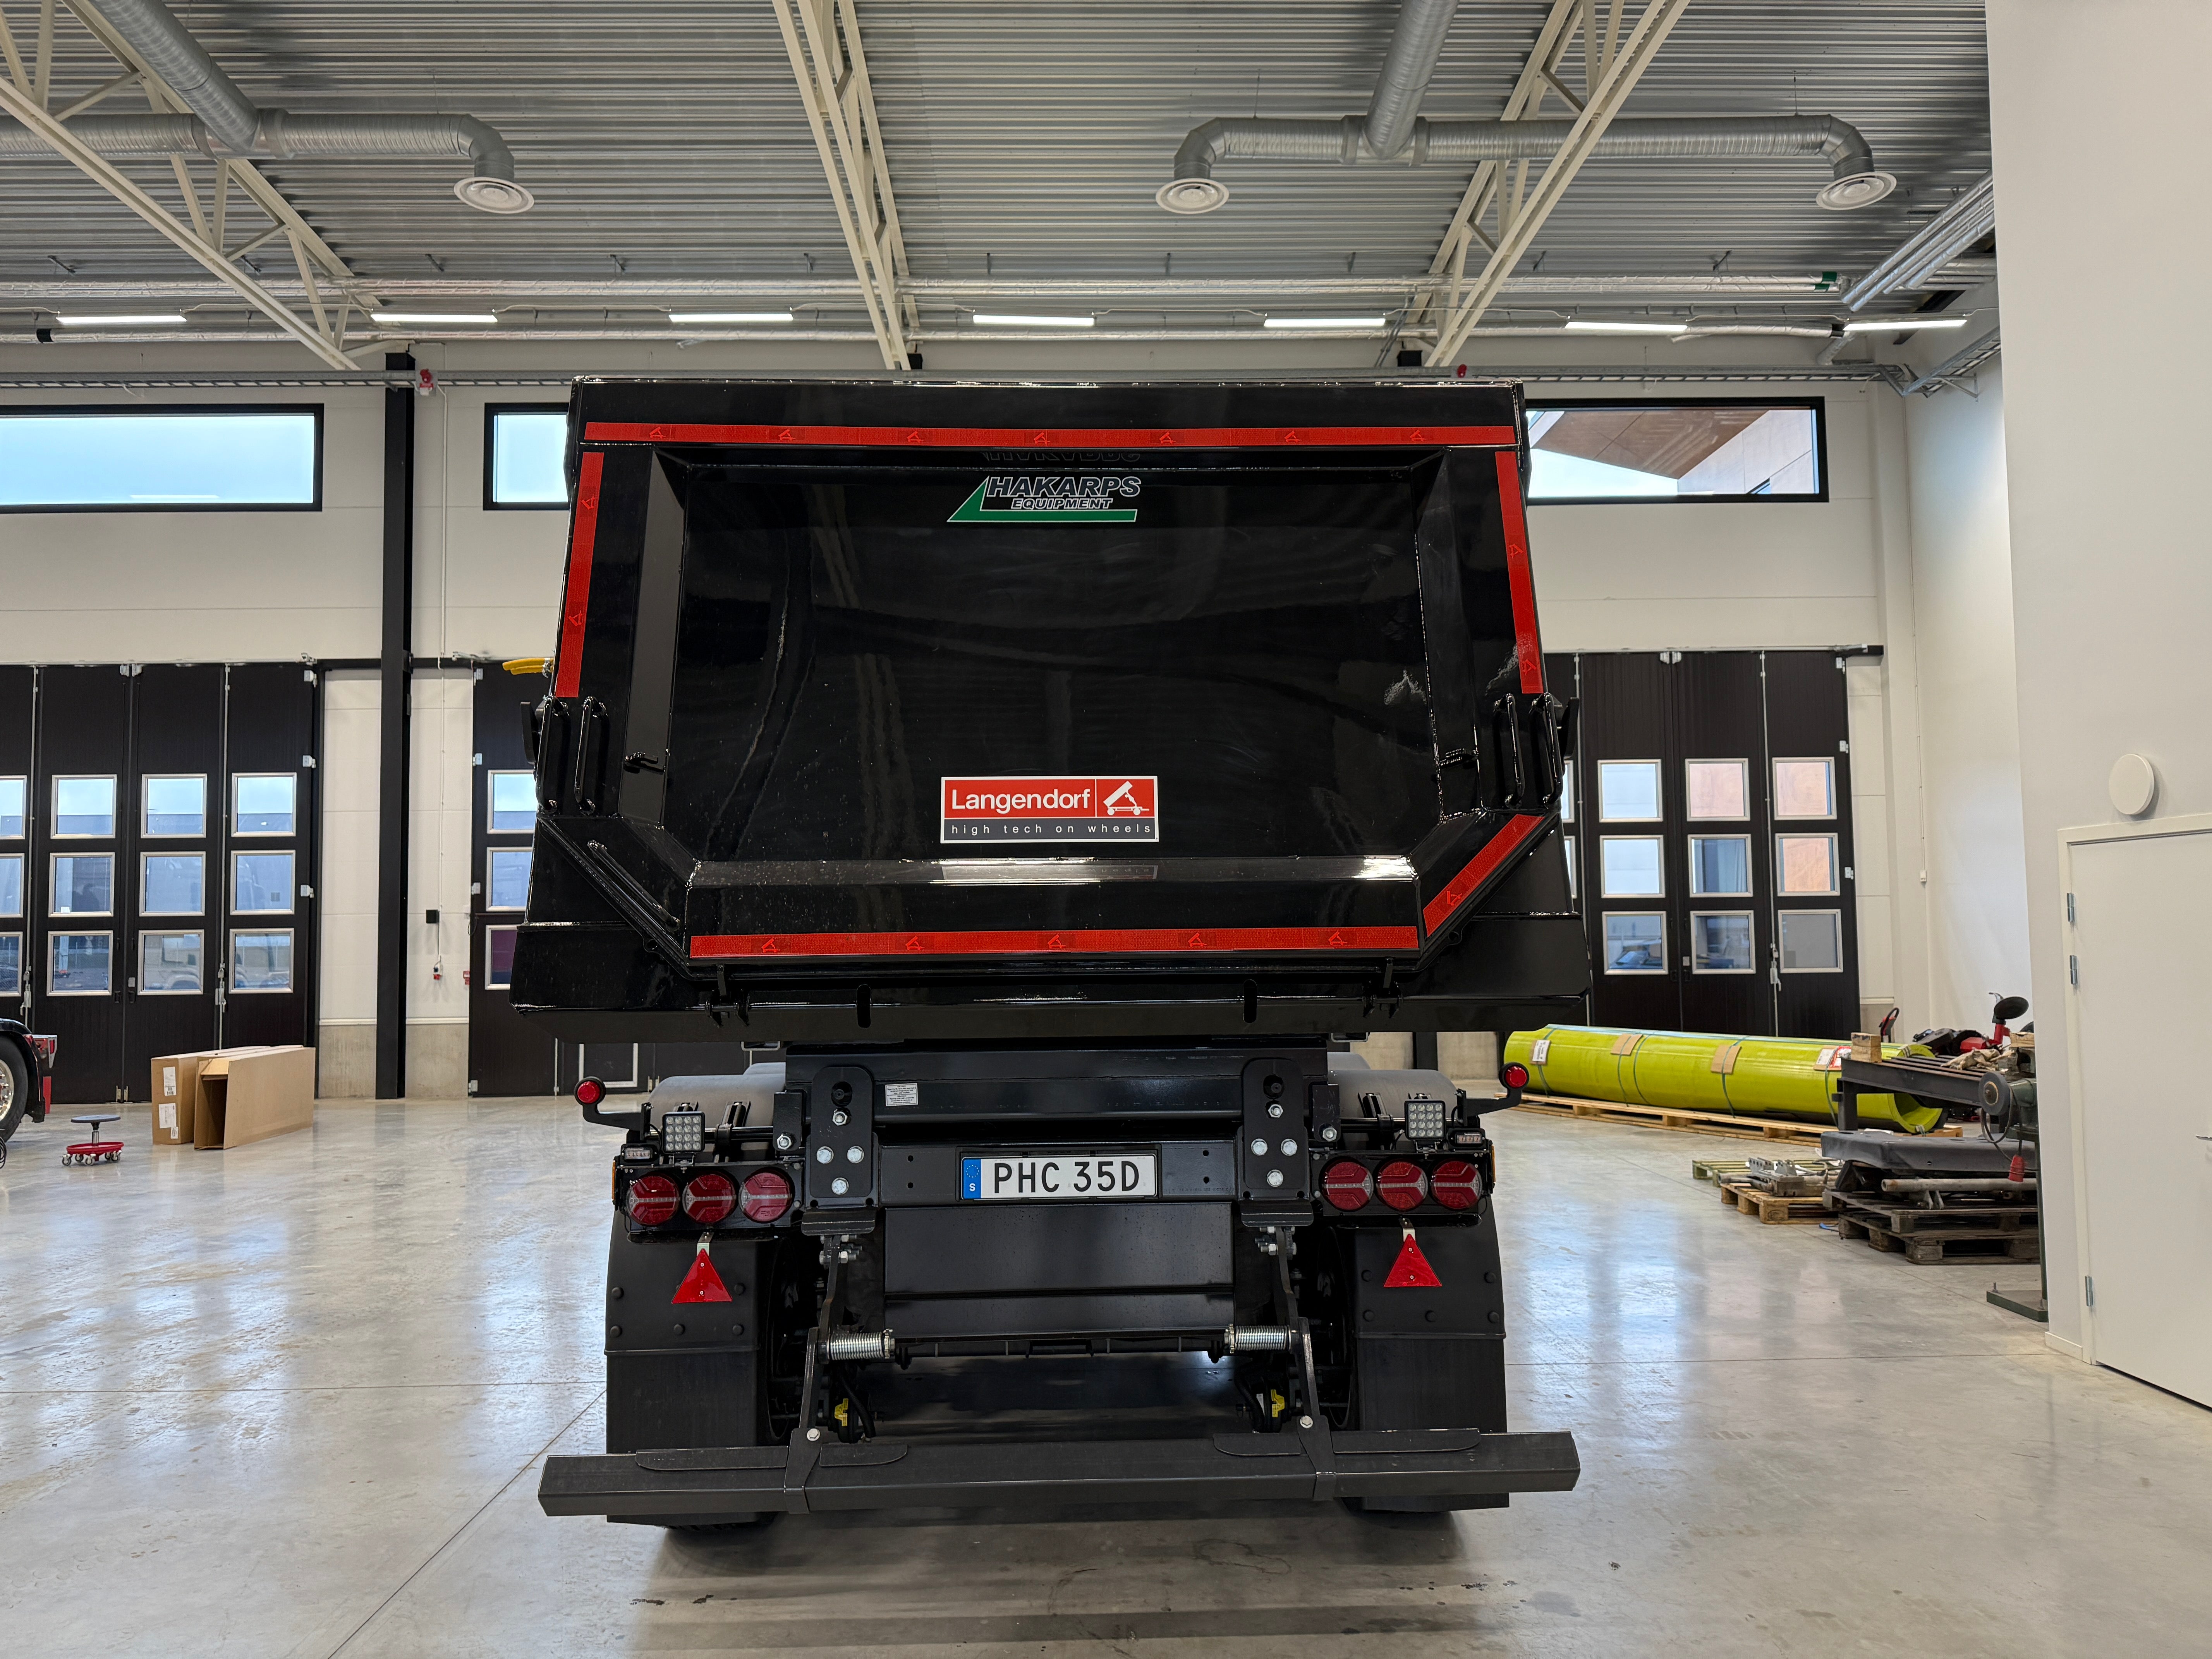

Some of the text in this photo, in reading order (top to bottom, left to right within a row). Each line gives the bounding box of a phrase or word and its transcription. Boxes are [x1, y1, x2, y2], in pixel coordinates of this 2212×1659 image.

[986, 476, 1141, 497] HAKARPS
[1011, 498, 1113, 510] EQUIPMENT
[951, 789, 1091, 814] Langendorf
[951, 825, 990, 836] high
[1004, 824, 1042, 833] tech
[1088, 824, 1151, 833] wheels
[994, 1161, 1139, 1193] PHC 35D
[969, 1183, 975, 1192] S
